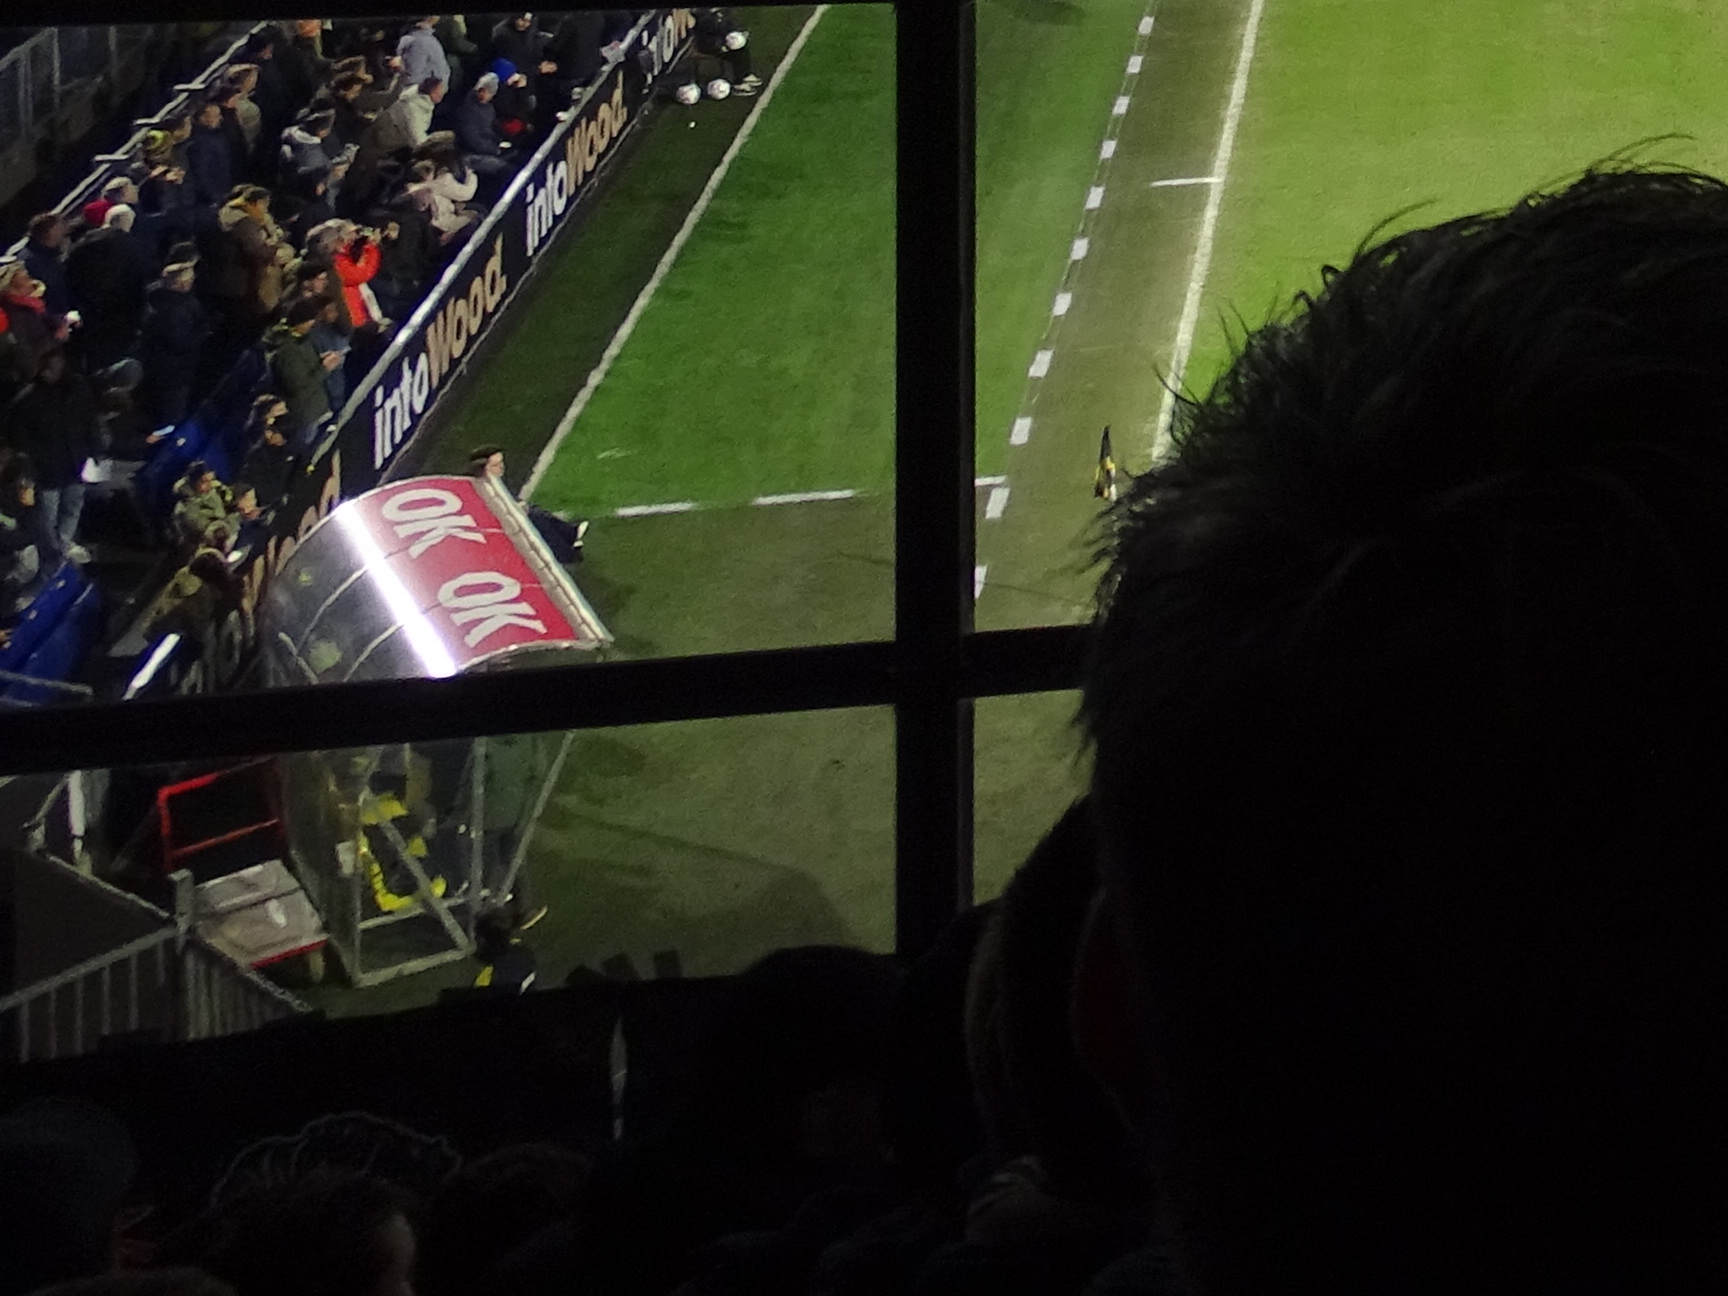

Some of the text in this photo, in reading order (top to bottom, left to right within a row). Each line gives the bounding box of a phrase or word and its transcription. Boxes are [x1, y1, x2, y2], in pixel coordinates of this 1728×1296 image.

[373, 234, 507, 470] intoWood.
[381, 487, 486, 559] OK
[436, 570, 547, 649] OK
